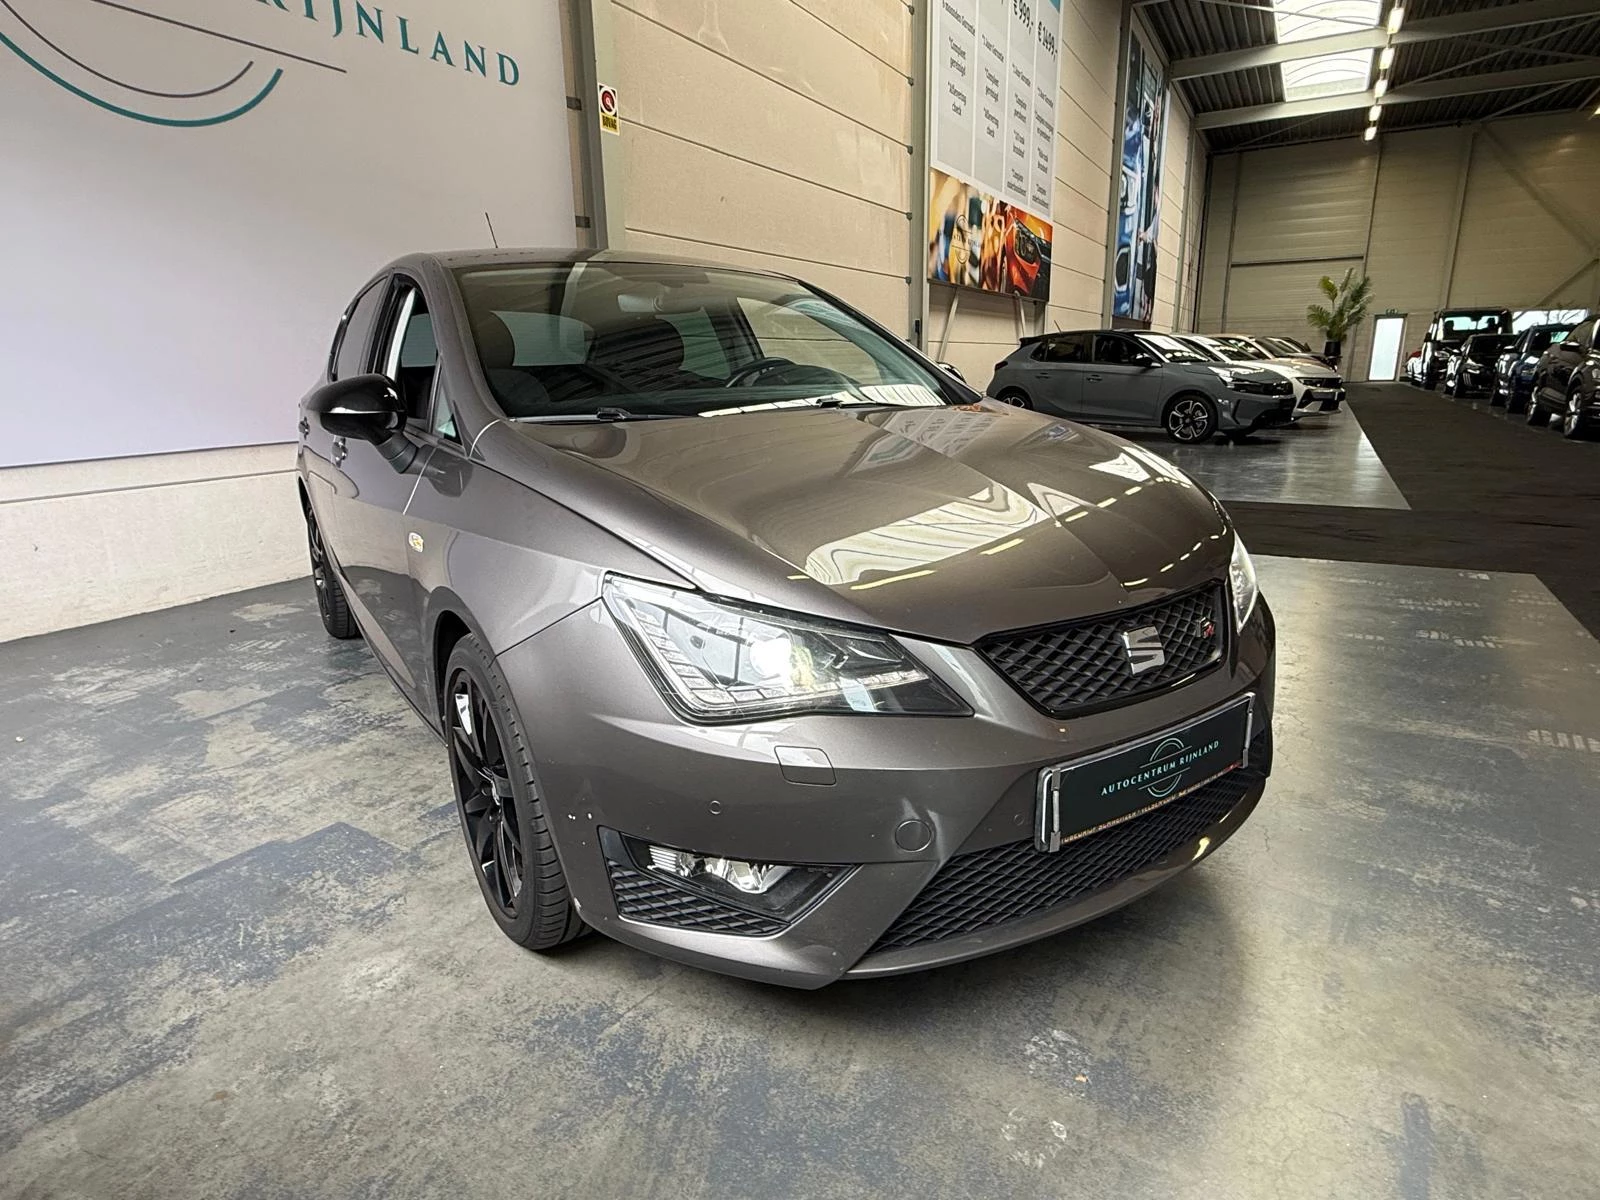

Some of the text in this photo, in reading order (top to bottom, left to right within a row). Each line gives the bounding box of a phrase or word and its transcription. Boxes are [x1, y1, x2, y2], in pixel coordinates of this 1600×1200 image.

[255, 0, 520, 87] IJNLAND
[1101, 762, 1176, 796] AUTOCENTRUM
[1179, 740, 1220, 766] RIJNLAND
